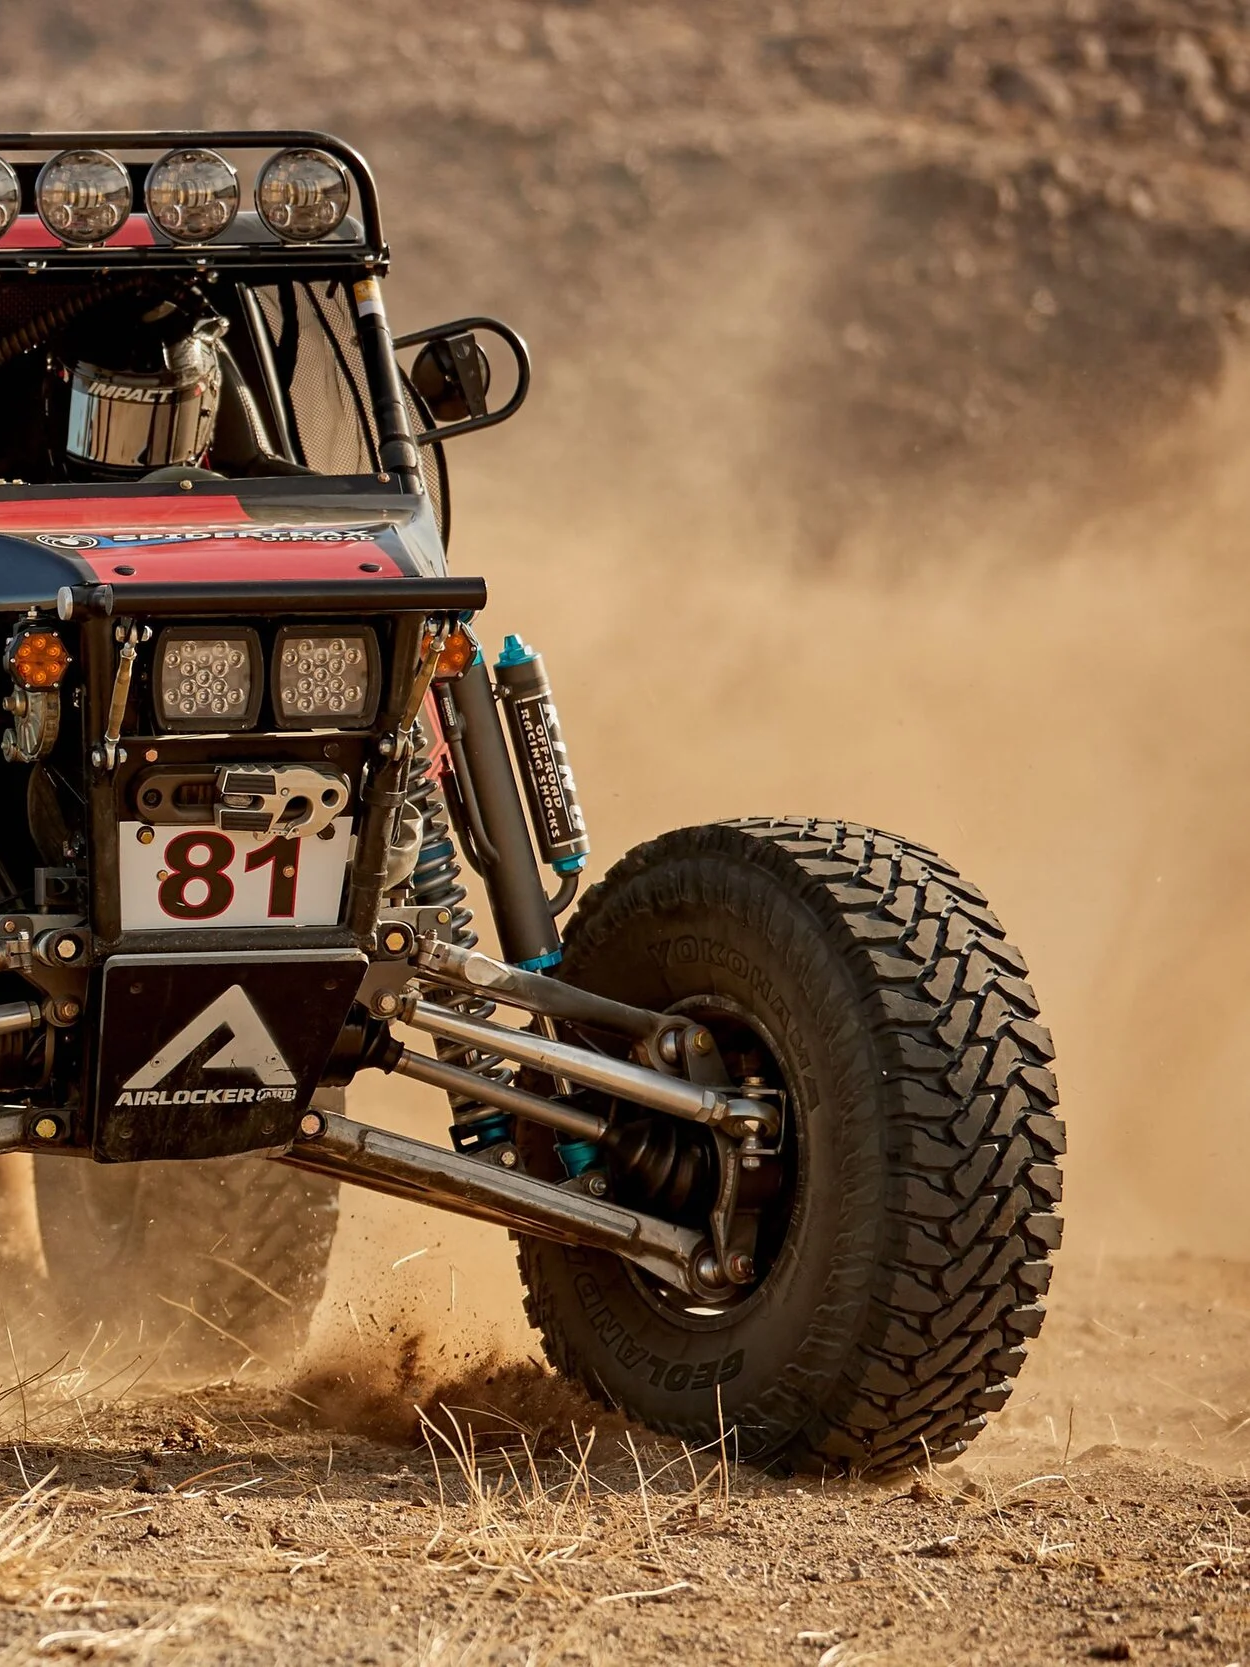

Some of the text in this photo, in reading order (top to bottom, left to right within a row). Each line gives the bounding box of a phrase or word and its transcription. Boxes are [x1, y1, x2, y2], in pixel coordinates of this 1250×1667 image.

[87, 382, 175, 403] IMPACT
[112, 529, 370, 542] SPIDERTRAX
[520, 709, 560, 839] RACING SHOCKS
[535, 724, 563, 809] OFF-ROAD
[543, 703, 586, 832] KING
[158, 831, 302, 920] 81
[114, 1088, 256, 1107] AIRLOCKER
[564, 1246, 745, 1392] GEOLAND
